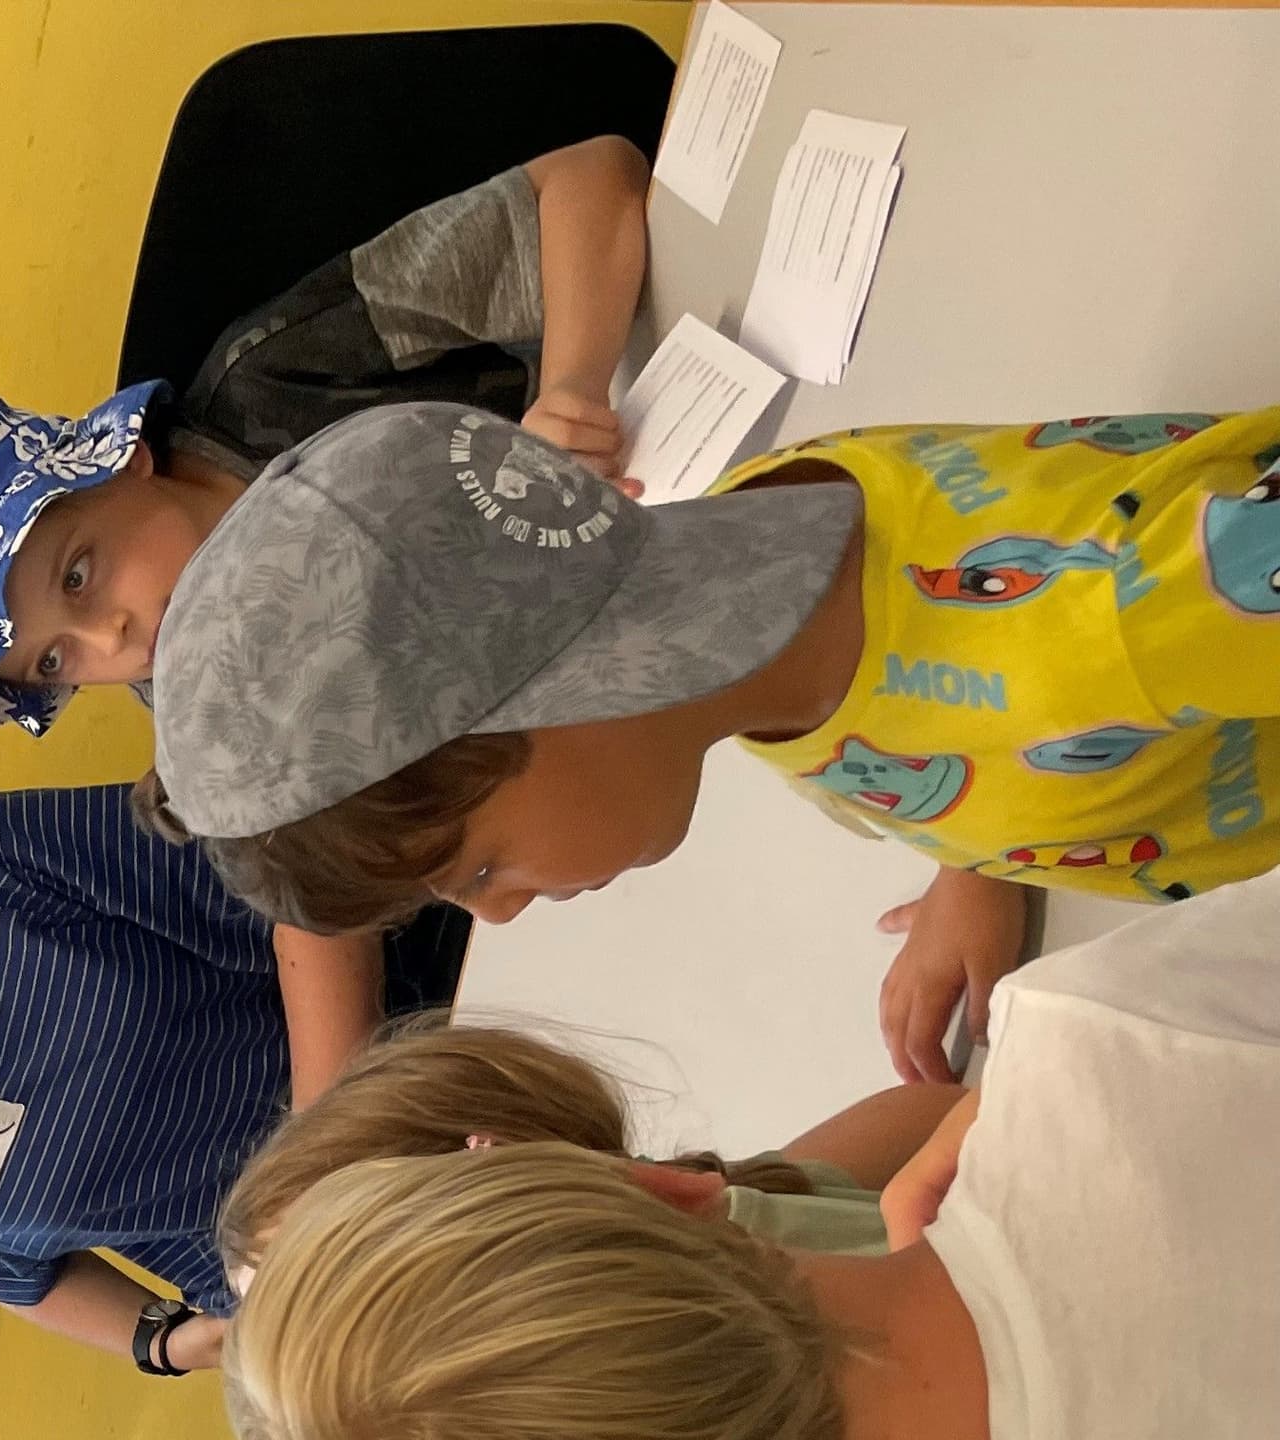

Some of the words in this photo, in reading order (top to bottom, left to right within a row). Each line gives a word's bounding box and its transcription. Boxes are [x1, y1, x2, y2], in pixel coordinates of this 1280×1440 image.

[450, 429, 472, 463] WILD
[456, 469, 503, 521] RULES
[536, 527, 572, 548] ONE
